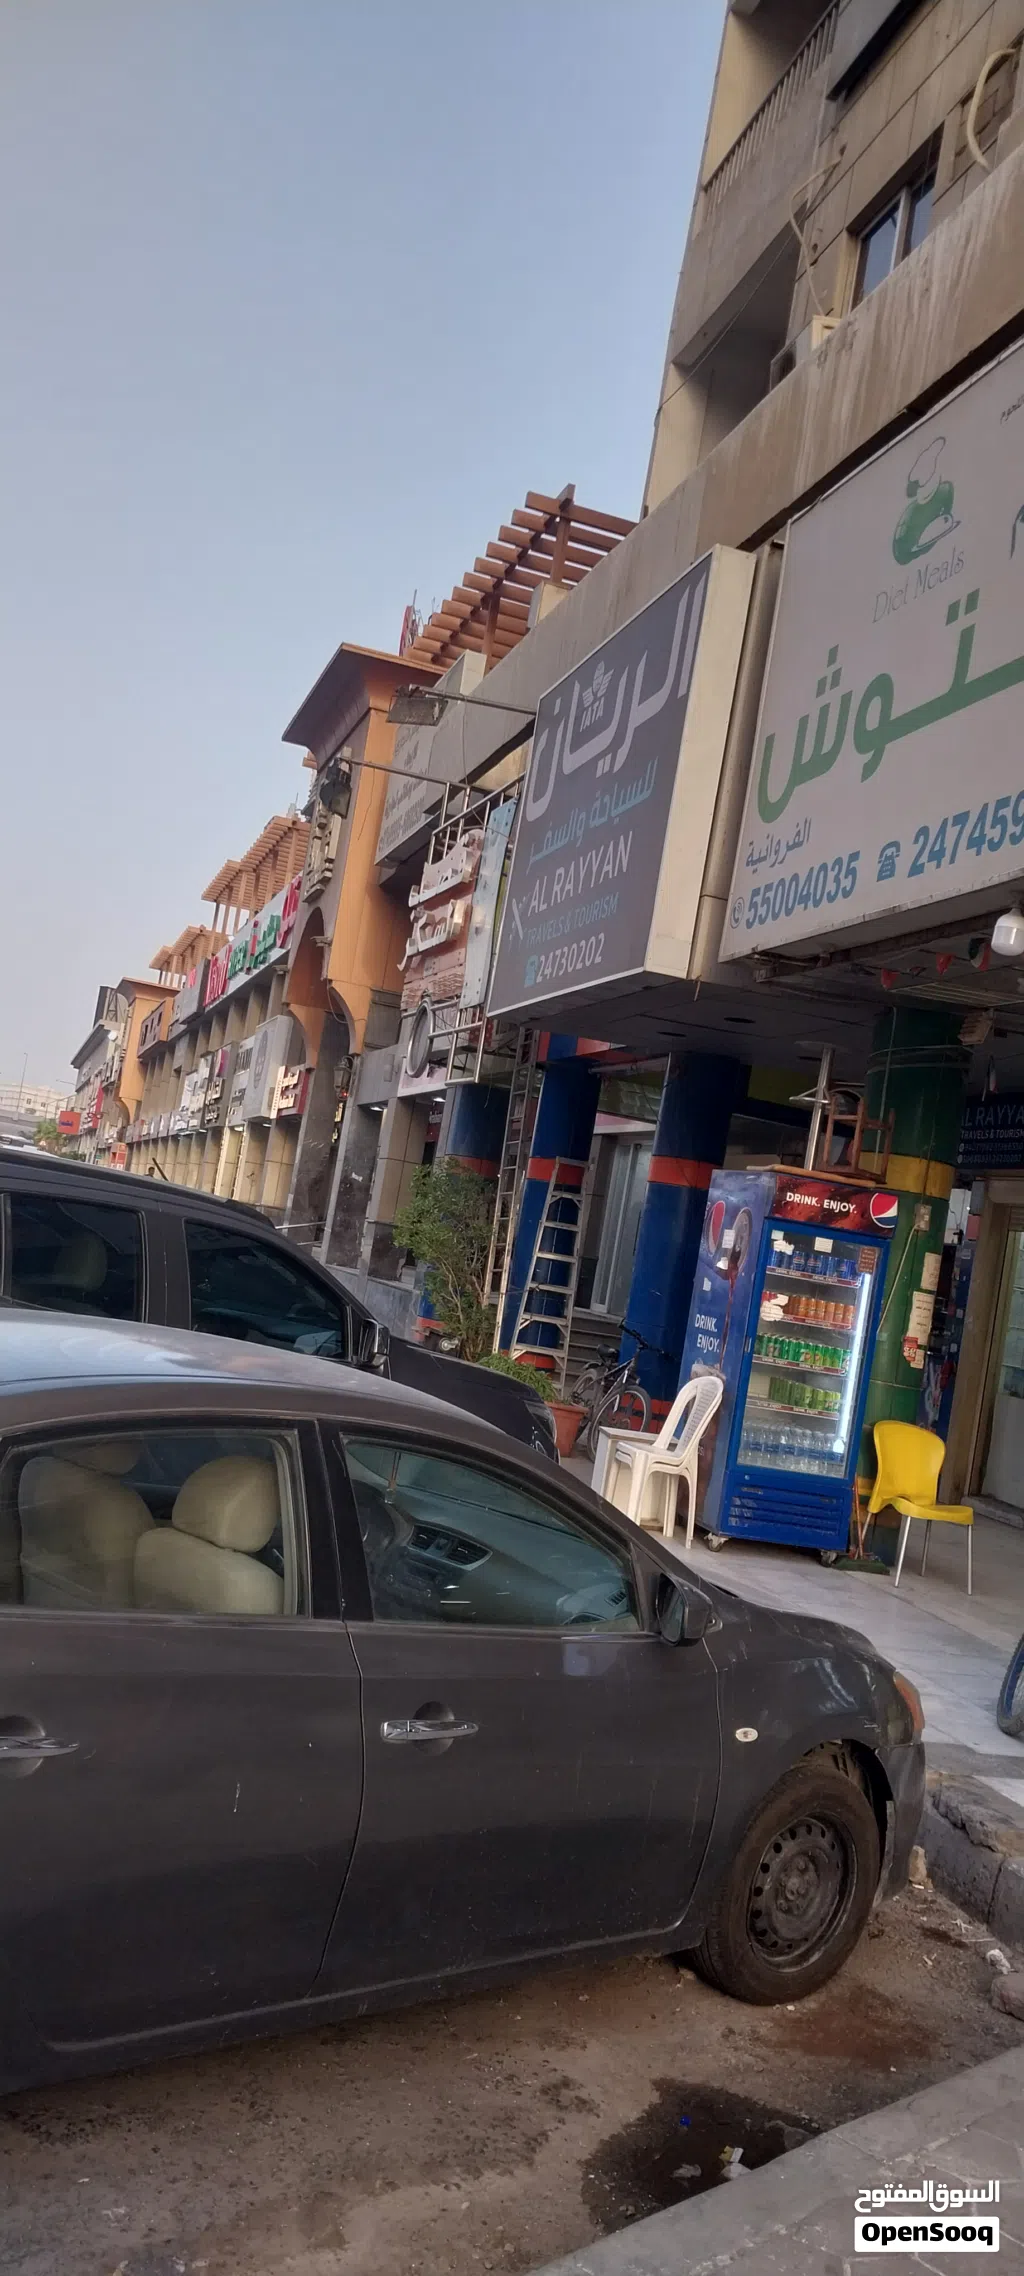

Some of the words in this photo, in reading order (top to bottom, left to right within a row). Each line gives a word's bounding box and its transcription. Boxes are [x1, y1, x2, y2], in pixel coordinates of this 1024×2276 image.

[913, 544, 965, 600] Meals
[526, 570, 707, 822] الريان
[579, 695, 604, 733] IATA
[757, 588, 1024, 824] توش
[589, 756, 659, 828] للسياحة
[526, 808, 586, 876] والسفر
[745, 818, 812, 875] الفروانية
[528, 876, 548, 917] AL
[550, 831, 633, 907] RAYYAN
[745, 850, 861, 930] 55004035
[526, 917, 564, 949] TRAVELS
[574, 891, 620, 928] TOURISM
[536, 932, 605, 984] 24730202
[786, 1192, 821, 1207] DRINK.
[823, 1199, 857, 1214] ENJOY.
[694, 1314, 718, 1333] DRINK.
[696, 1334, 720, 1353] ENJOY.
